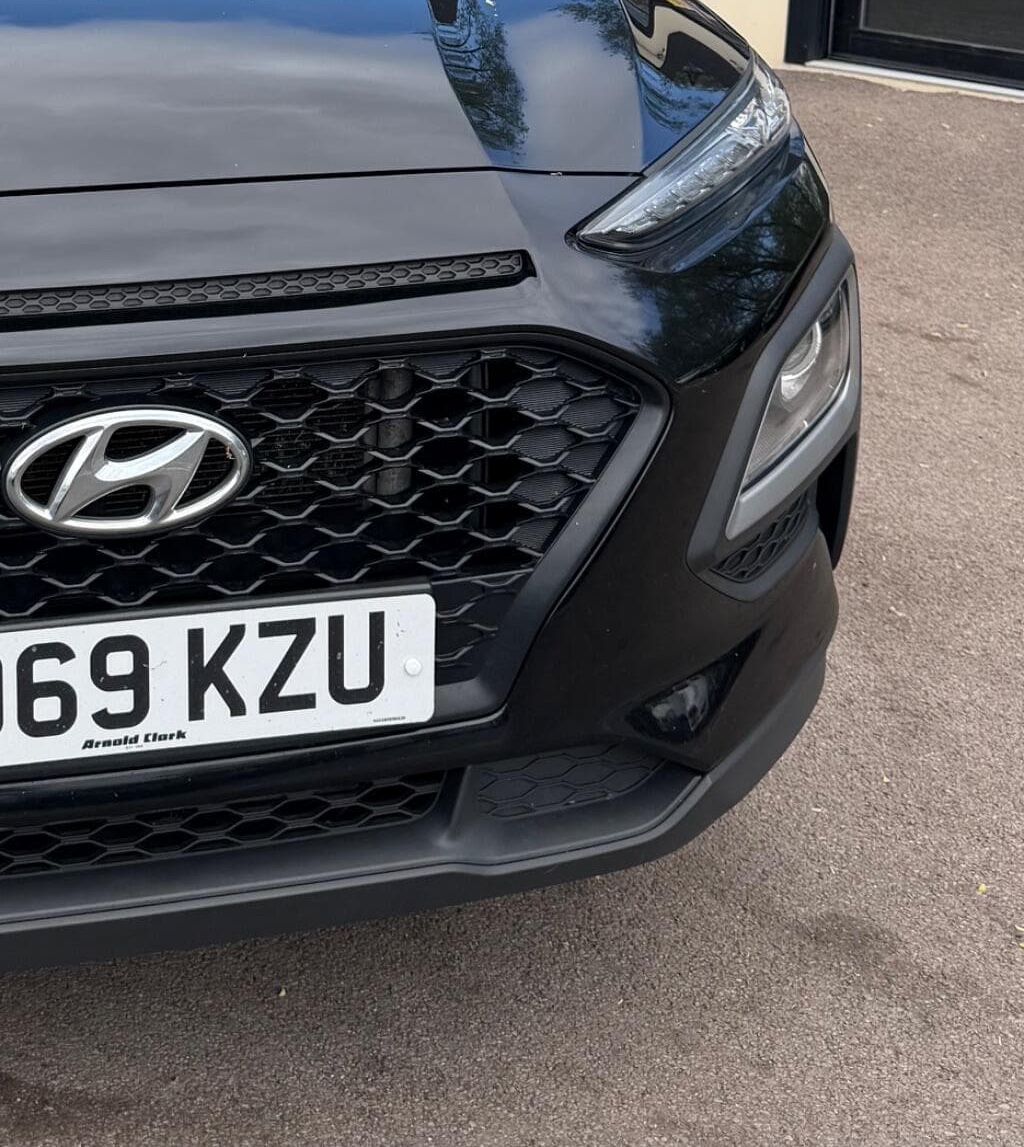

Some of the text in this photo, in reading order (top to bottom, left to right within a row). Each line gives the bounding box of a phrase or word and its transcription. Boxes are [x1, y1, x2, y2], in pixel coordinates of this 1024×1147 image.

[187, 610, 386, 722] KZU
[81, 730, 187, 750] Arnold Clark
